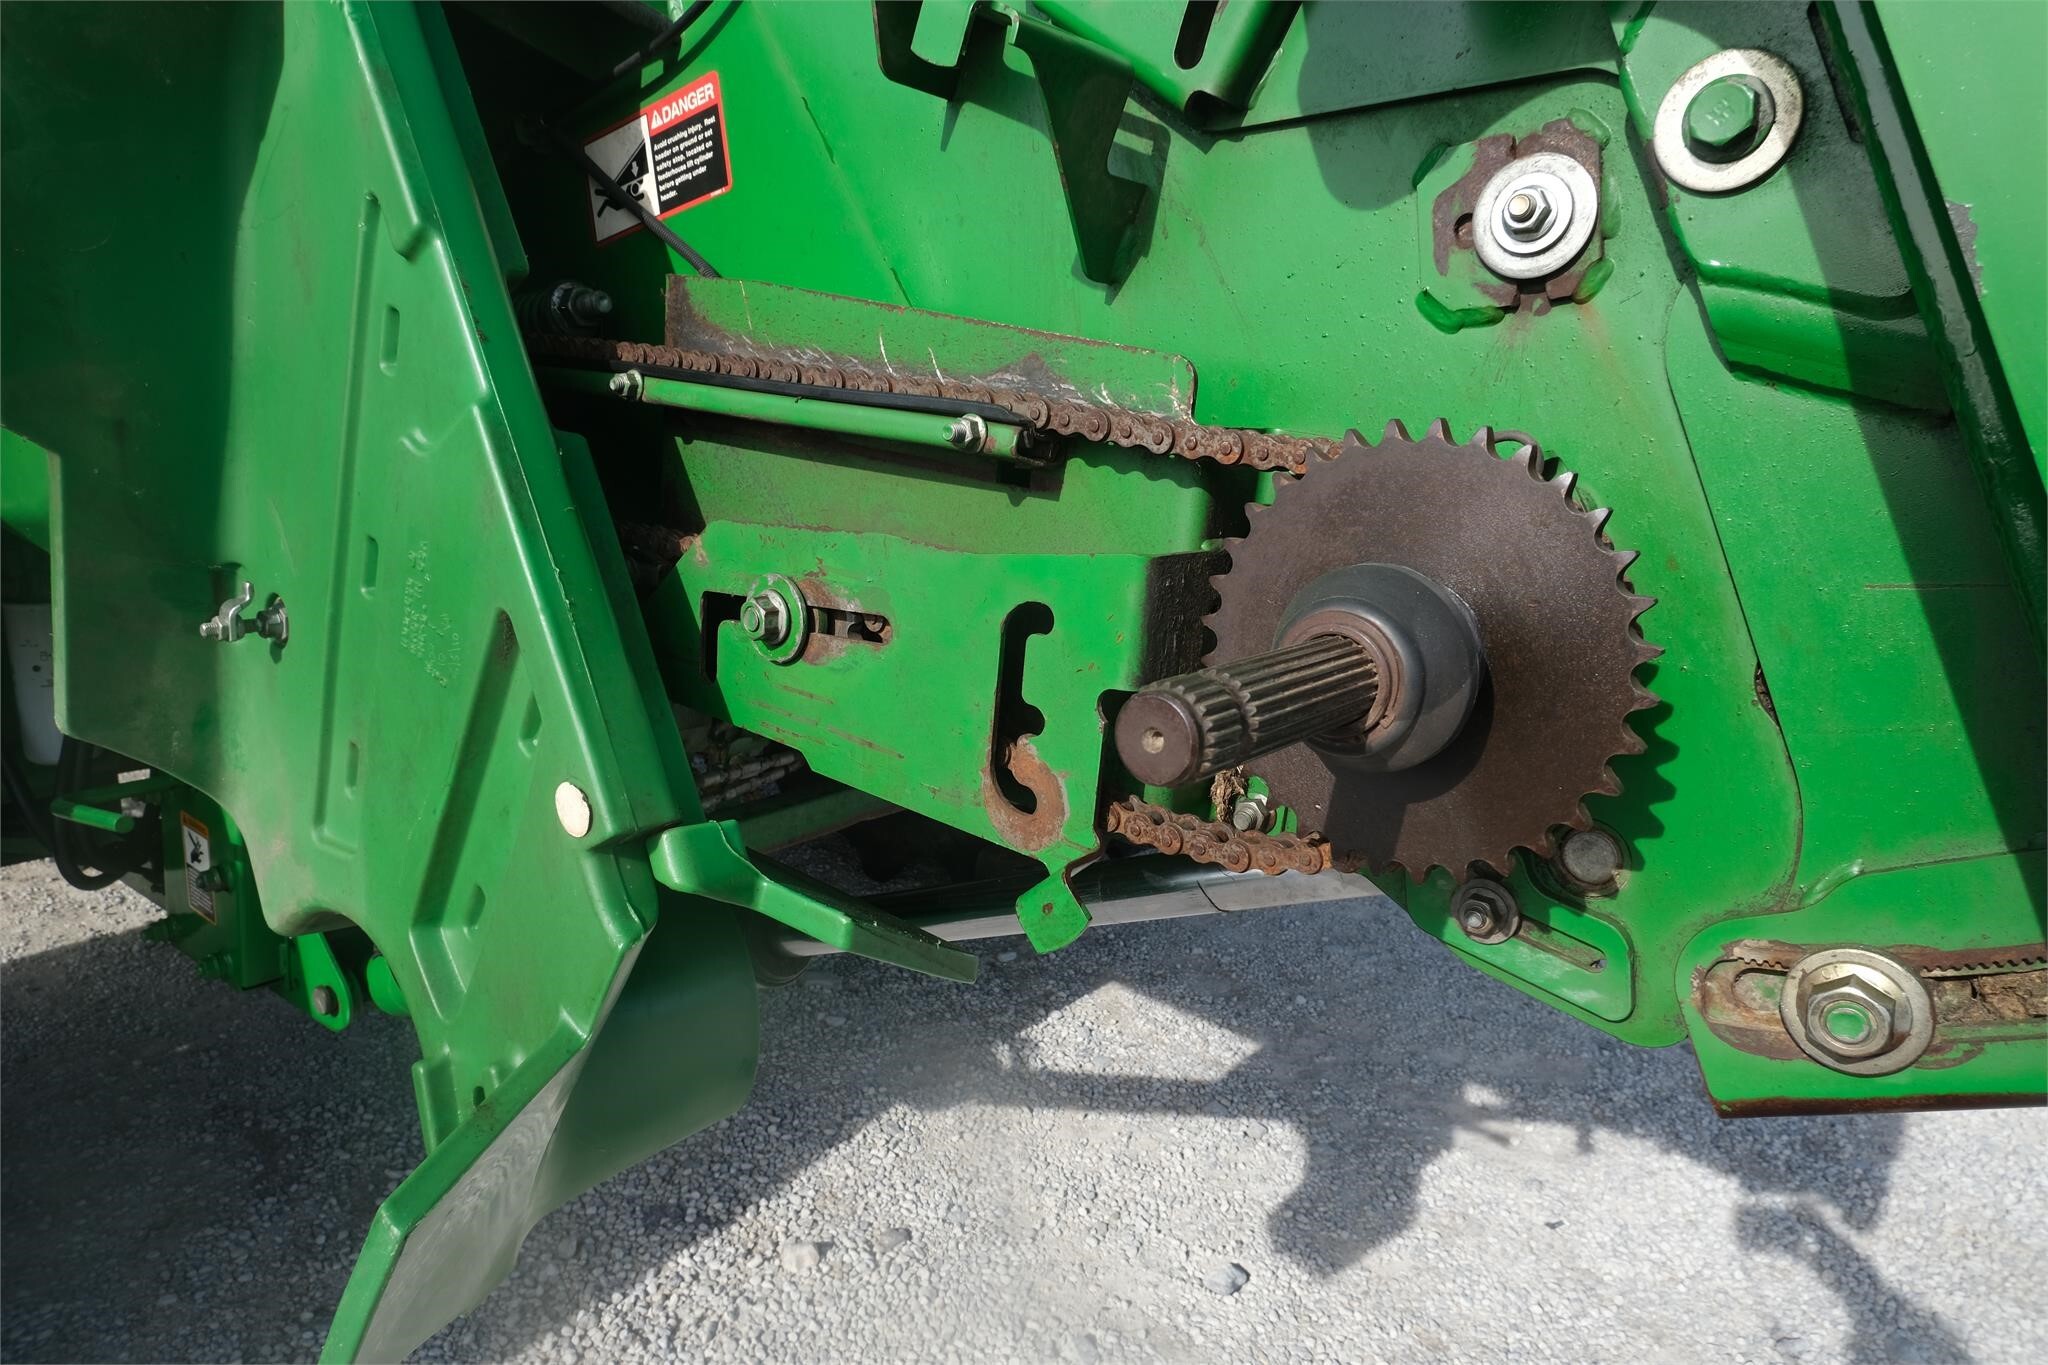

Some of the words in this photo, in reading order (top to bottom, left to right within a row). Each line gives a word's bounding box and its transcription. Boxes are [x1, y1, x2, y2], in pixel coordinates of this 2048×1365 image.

[661, 82, 715, 124] DANGER
[654, 139, 668, 151] Avoid
[667, 130, 688, 144] crushing
[655, 149, 672, 161] header
[672, 145, 680, 153] on
[680, 134, 698, 151] ground
[698, 133, 704, 141] or
[704, 128, 713, 138] set
[656, 160, 672, 172] safety
[686, 143, 705, 158] located
[705, 140, 713, 149] on
[658, 164, 687, 181] feederhouse
[686, 160, 694, 168] lift
[693, 151, 713, 165] cylinder
[659, 180, 675, 192] before
[675, 172, 692, 186] getting
[692, 165, 707, 177] under
[660, 190, 678, 202] header.
